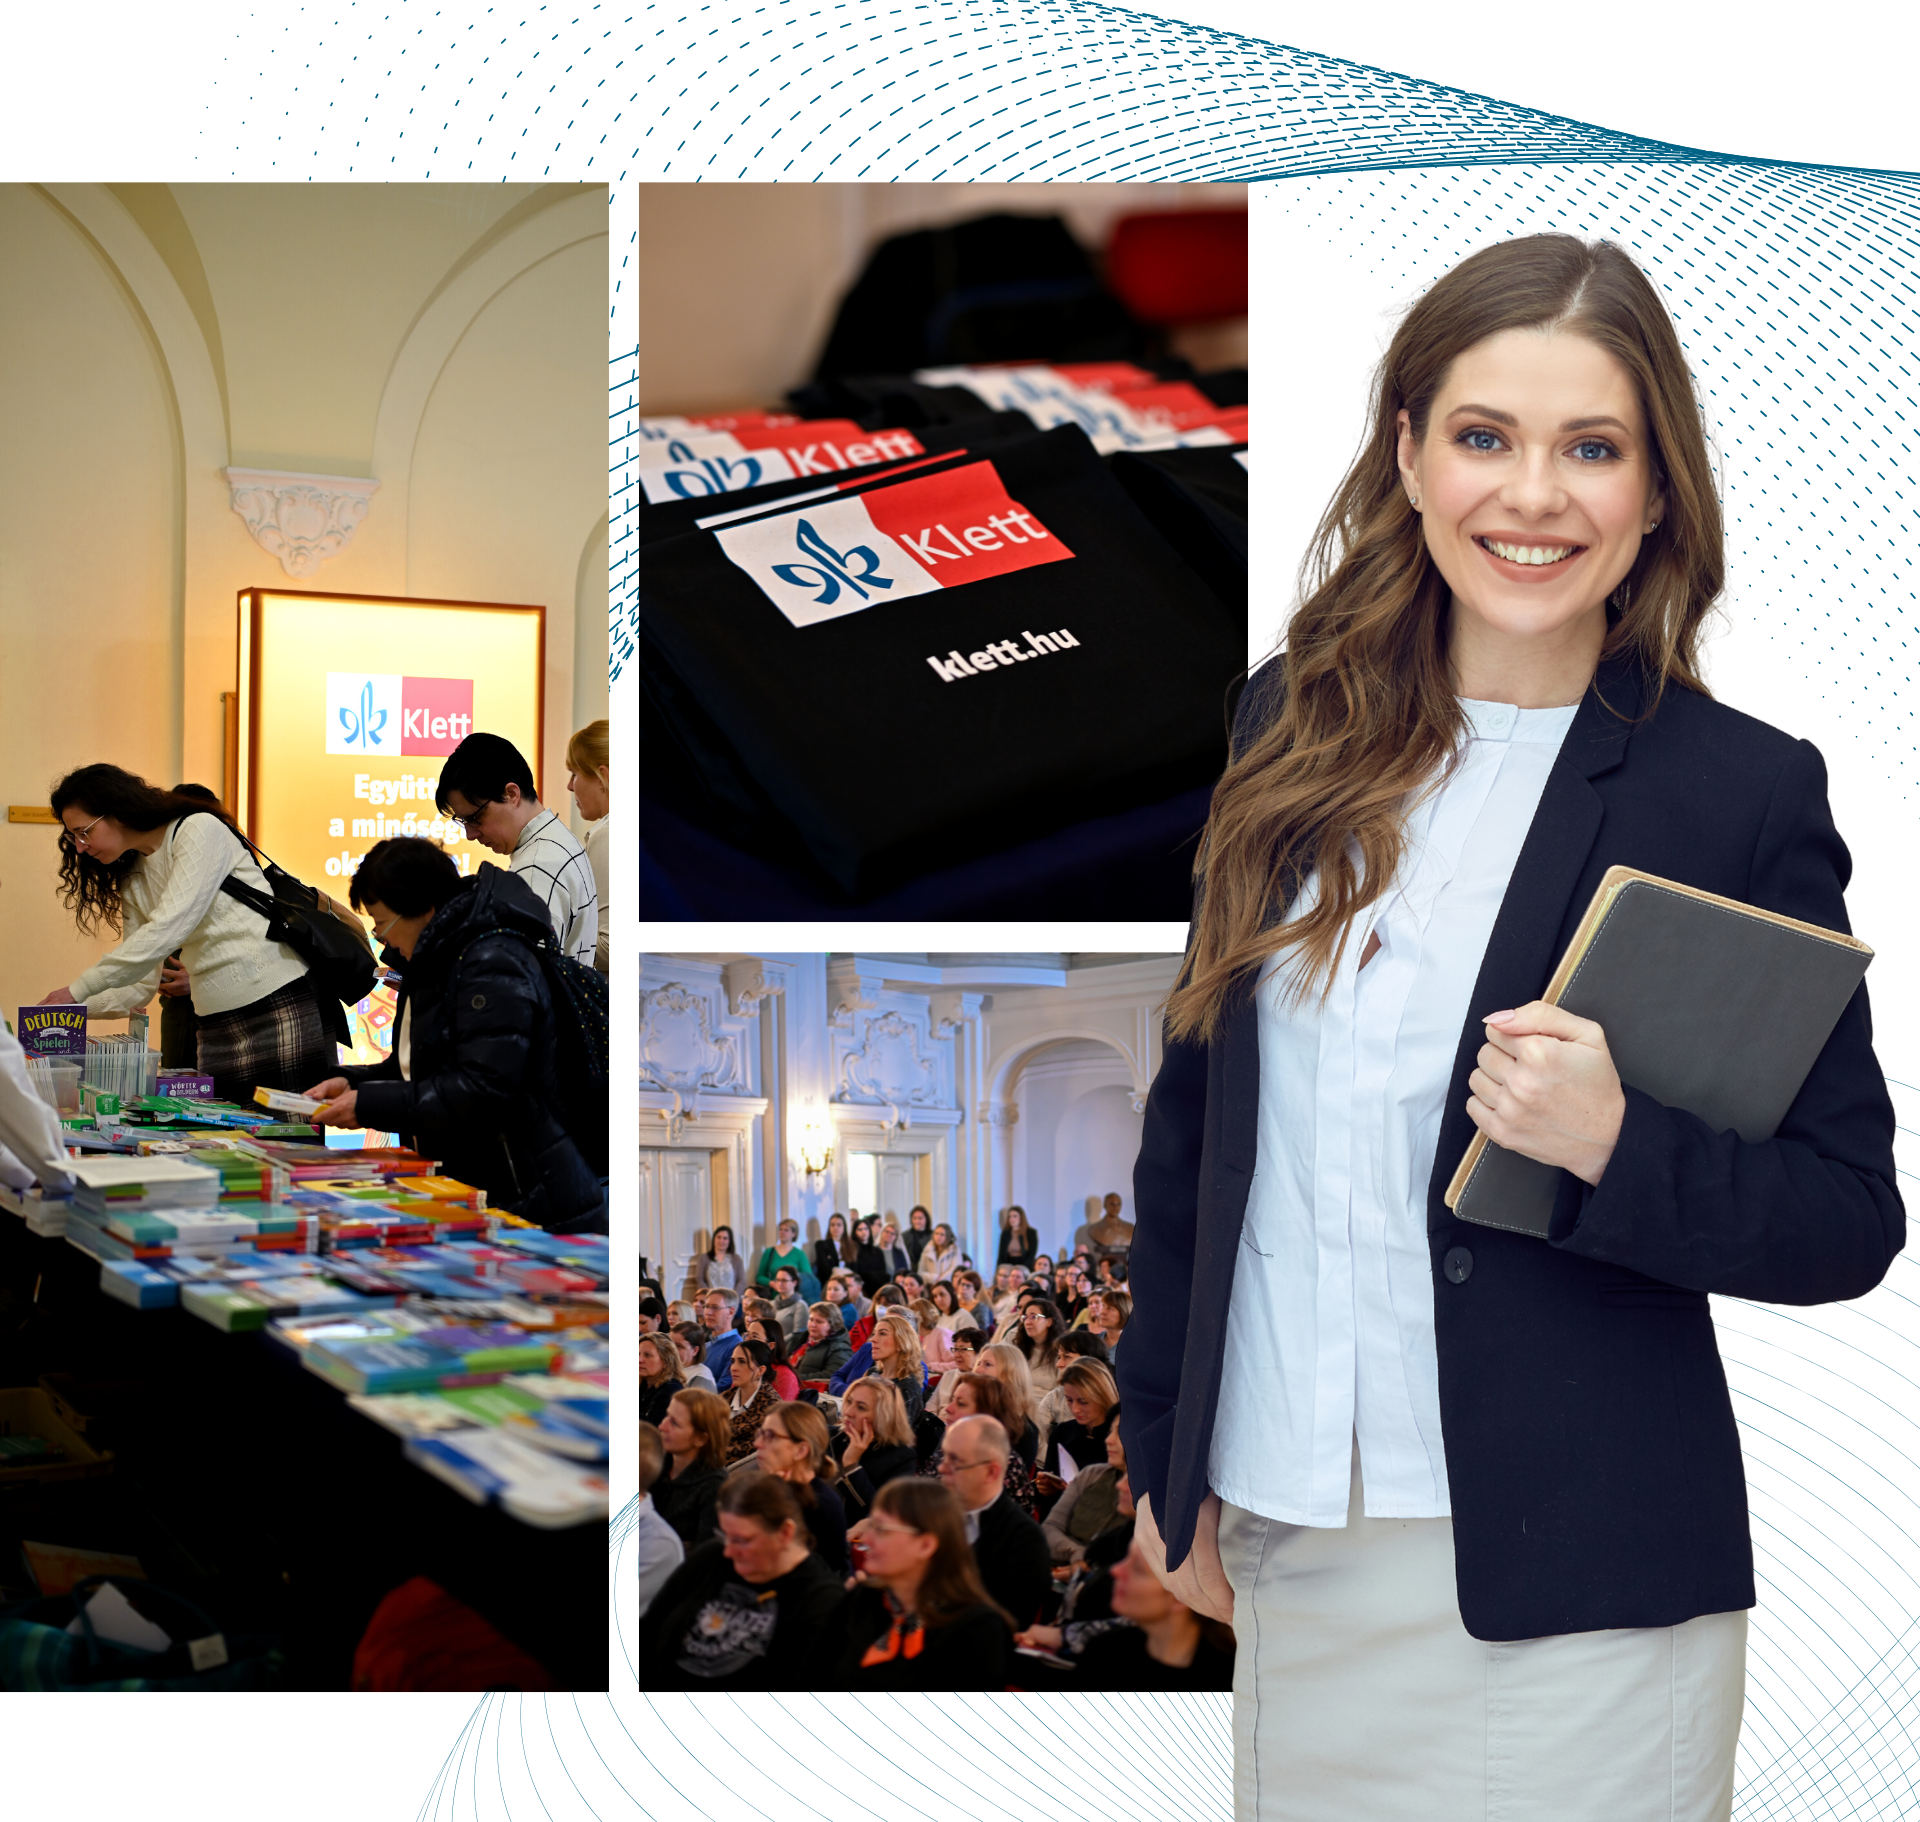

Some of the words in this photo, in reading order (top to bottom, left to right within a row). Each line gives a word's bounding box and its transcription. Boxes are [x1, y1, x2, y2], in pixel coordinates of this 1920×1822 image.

[787, 432, 915, 477] Klett
[899, 509, 1049, 566] Klett
[926, 628, 1081, 683] klett.hu
[404, 708, 471, 740] Klett
[354, 773, 439, 806] Együtt
[328, 818, 344, 837] a
[24, 1012, 85, 1032] DEUTSCH
[33, 1036, 71, 1051] Spielen
[171, 1081, 197, 1090] WÖRTER
